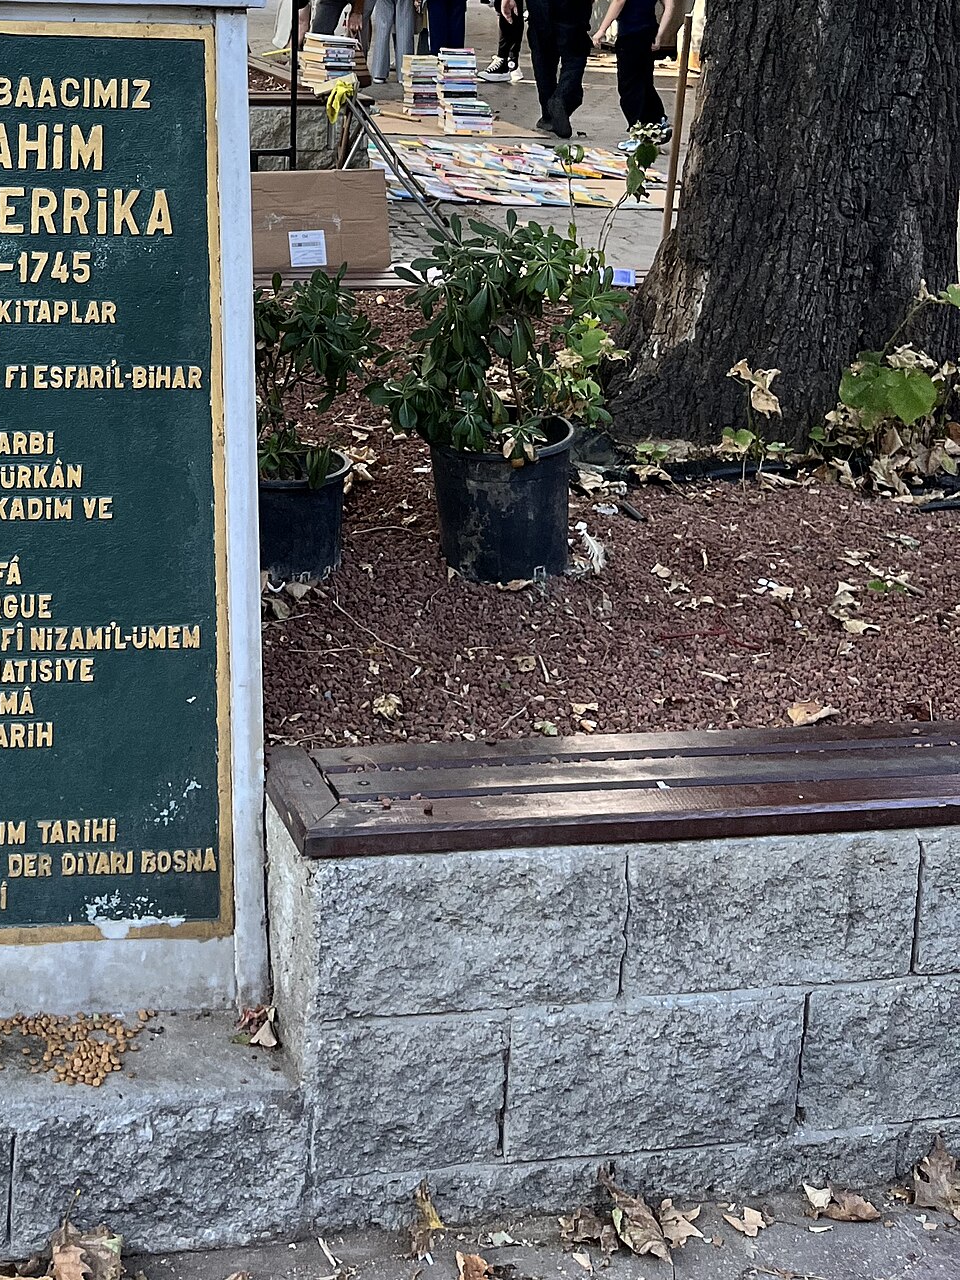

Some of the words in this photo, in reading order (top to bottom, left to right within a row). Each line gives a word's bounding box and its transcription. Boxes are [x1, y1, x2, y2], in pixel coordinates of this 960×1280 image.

[5, 364, 27, 389] Fİ
[82, 496, 113, 519] VE
[37, 817, 116, 844] TARİHİ
[7, 853, 52, 878] DER
[61, 850, 134, 876] DİYARI
[140, 847, 217, 873] BOSNA
